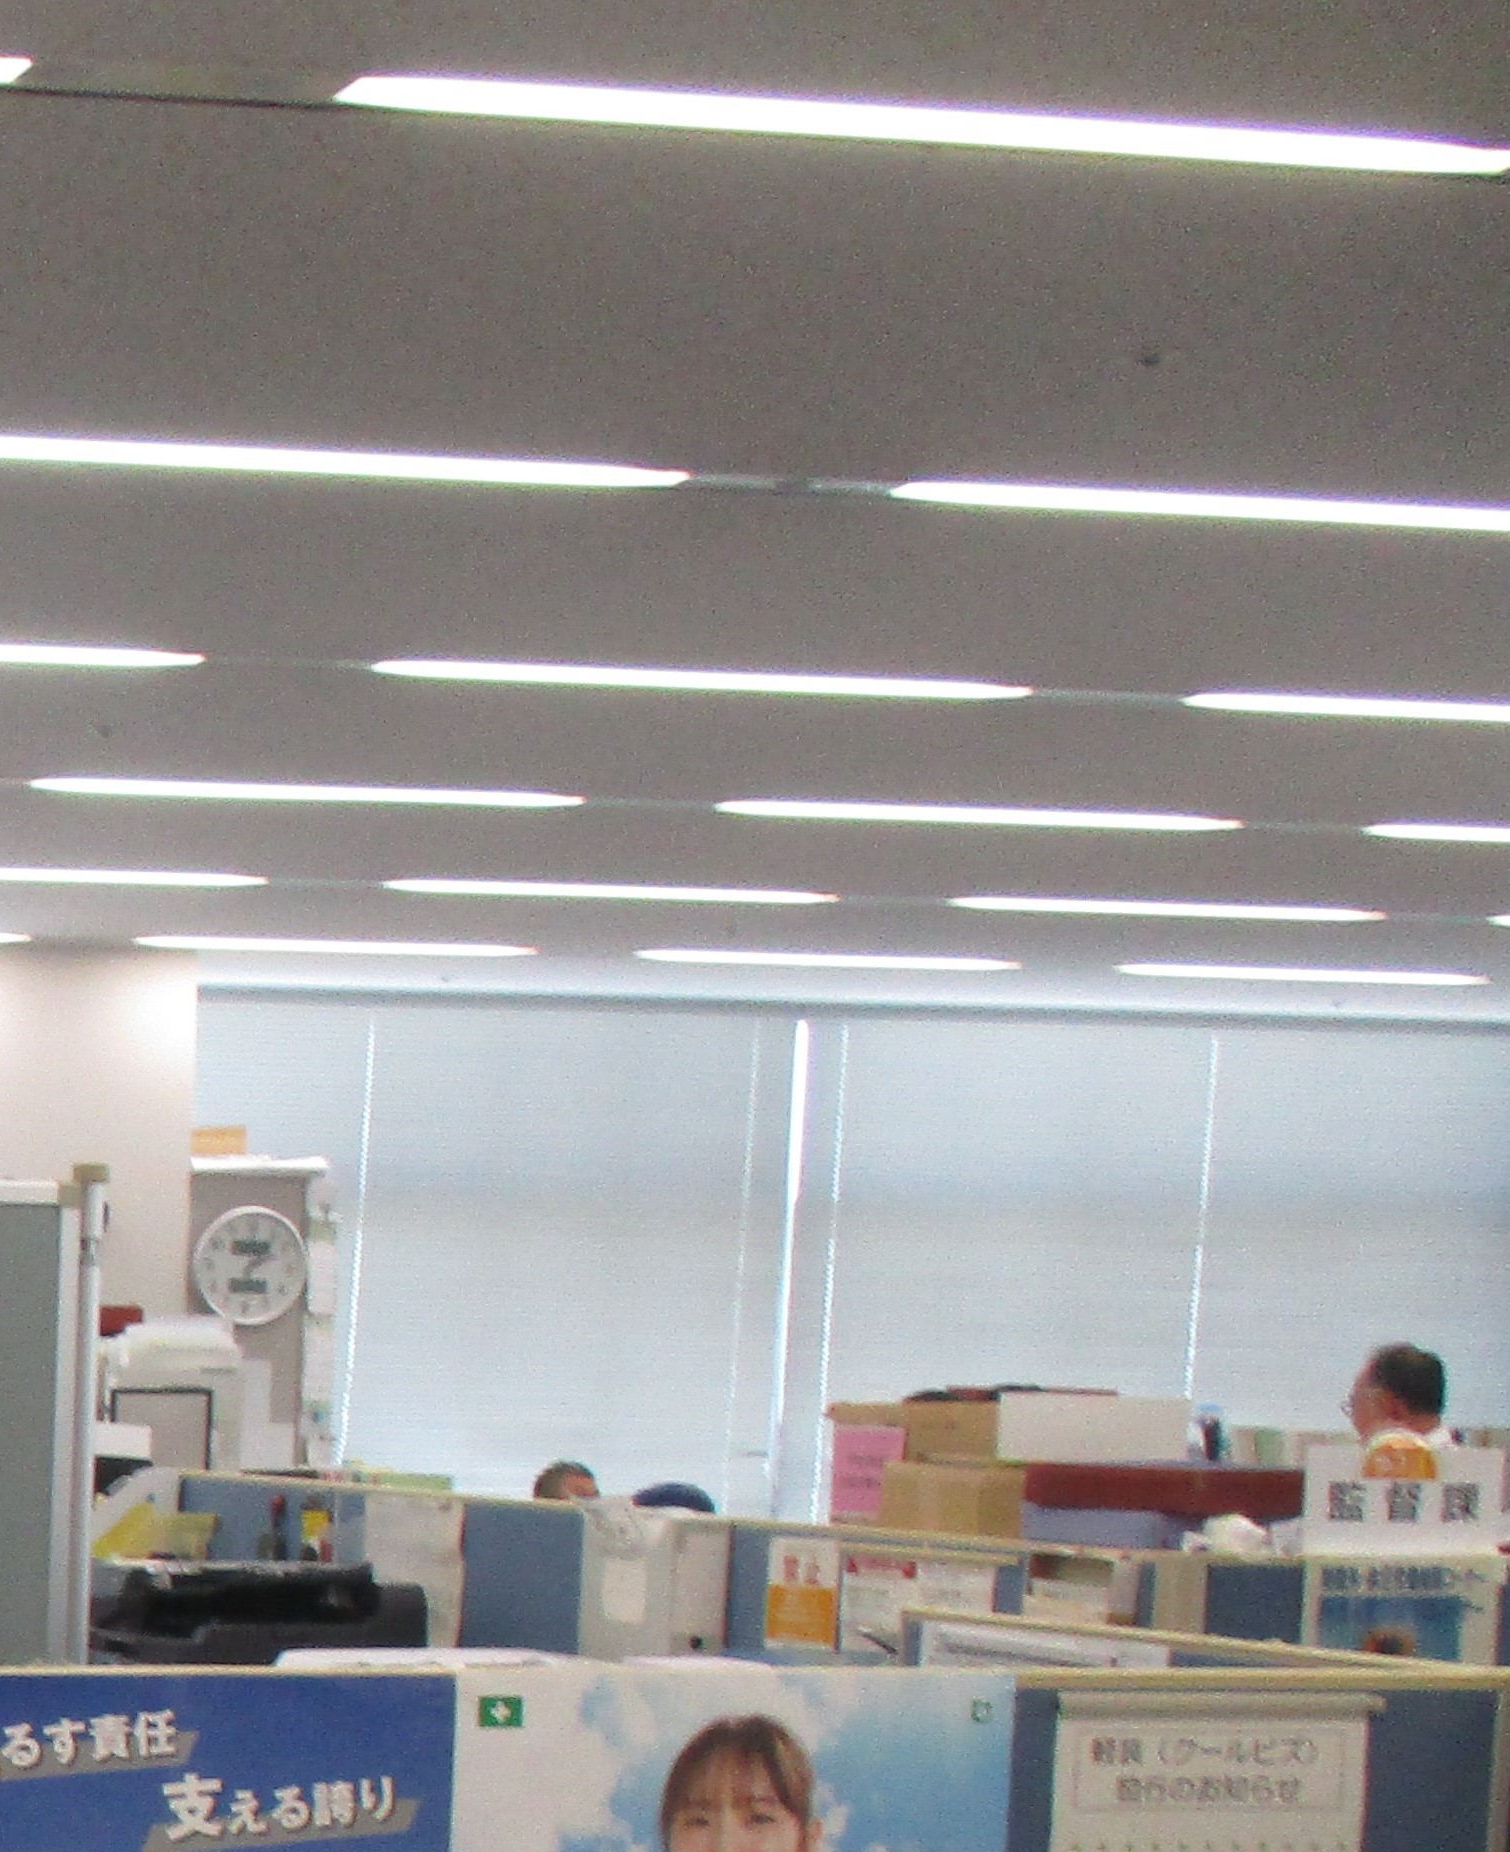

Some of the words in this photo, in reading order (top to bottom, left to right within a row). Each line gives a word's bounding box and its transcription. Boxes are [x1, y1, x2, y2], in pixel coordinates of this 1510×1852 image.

[161, 1772, 397, 1842] 支える誇り
